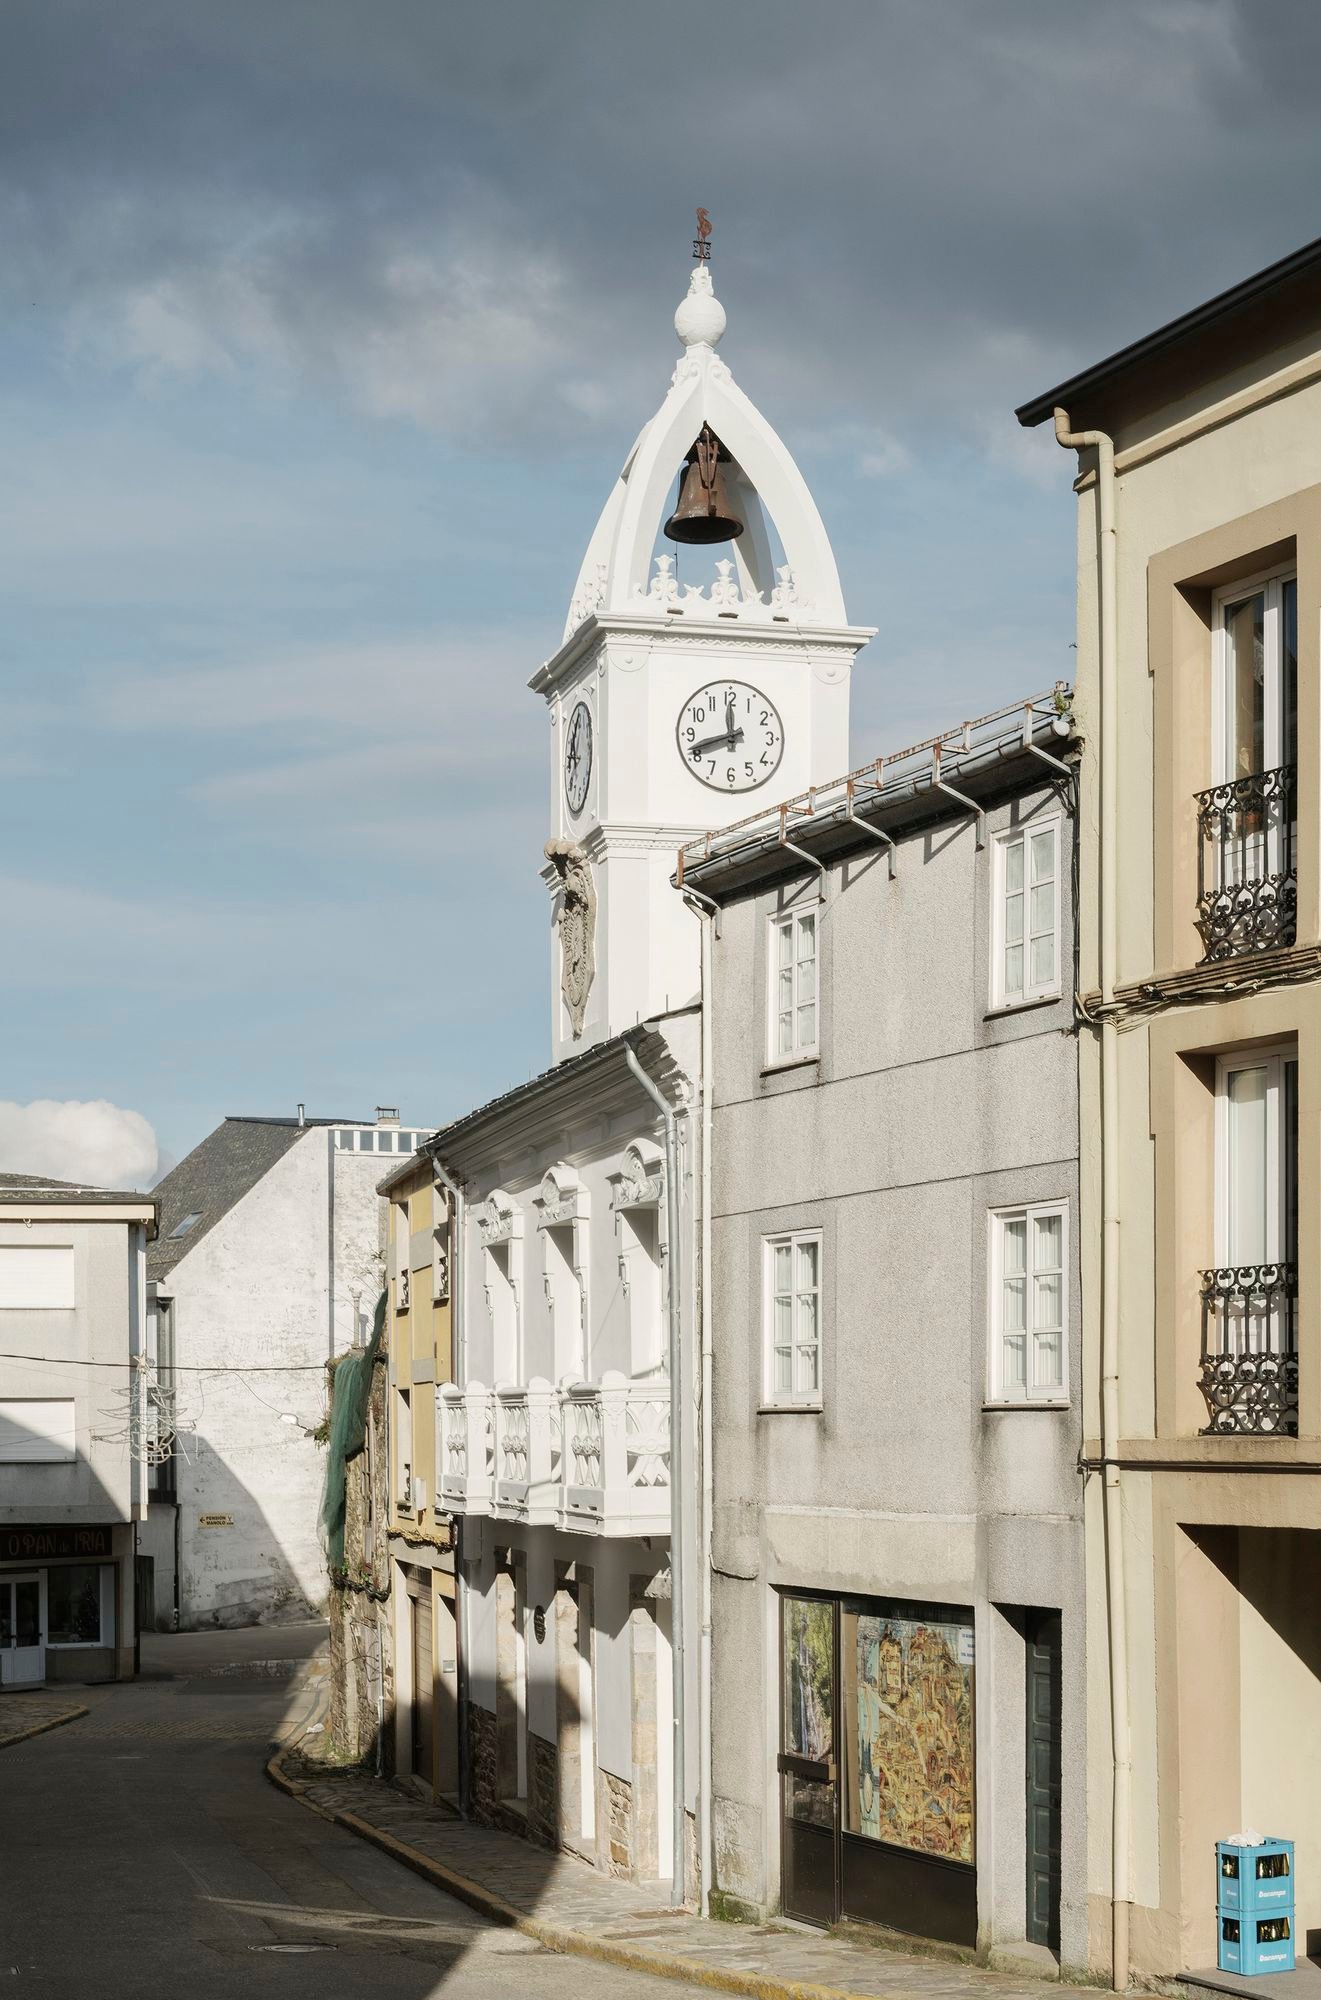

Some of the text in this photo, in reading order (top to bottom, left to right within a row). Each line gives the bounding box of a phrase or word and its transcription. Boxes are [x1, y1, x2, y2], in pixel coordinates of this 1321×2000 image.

[708, 696, 716, 711] 11
[724, 691, 737, 707] 12
[693, 707, 705, 722] 10
[760, 711, 768, 726] 2
[686, 727, 695, 742] 9
[765, 731, 774, 746] 3
[693, 749, 702, 762] 8
[760, 751, 768, 766] 4
[707, 760, 716, 775] 7
[727, 767, 735, 782] 6
[745, 762, 754, 777] 5
[22, 1532, 57, 1555] PAN
